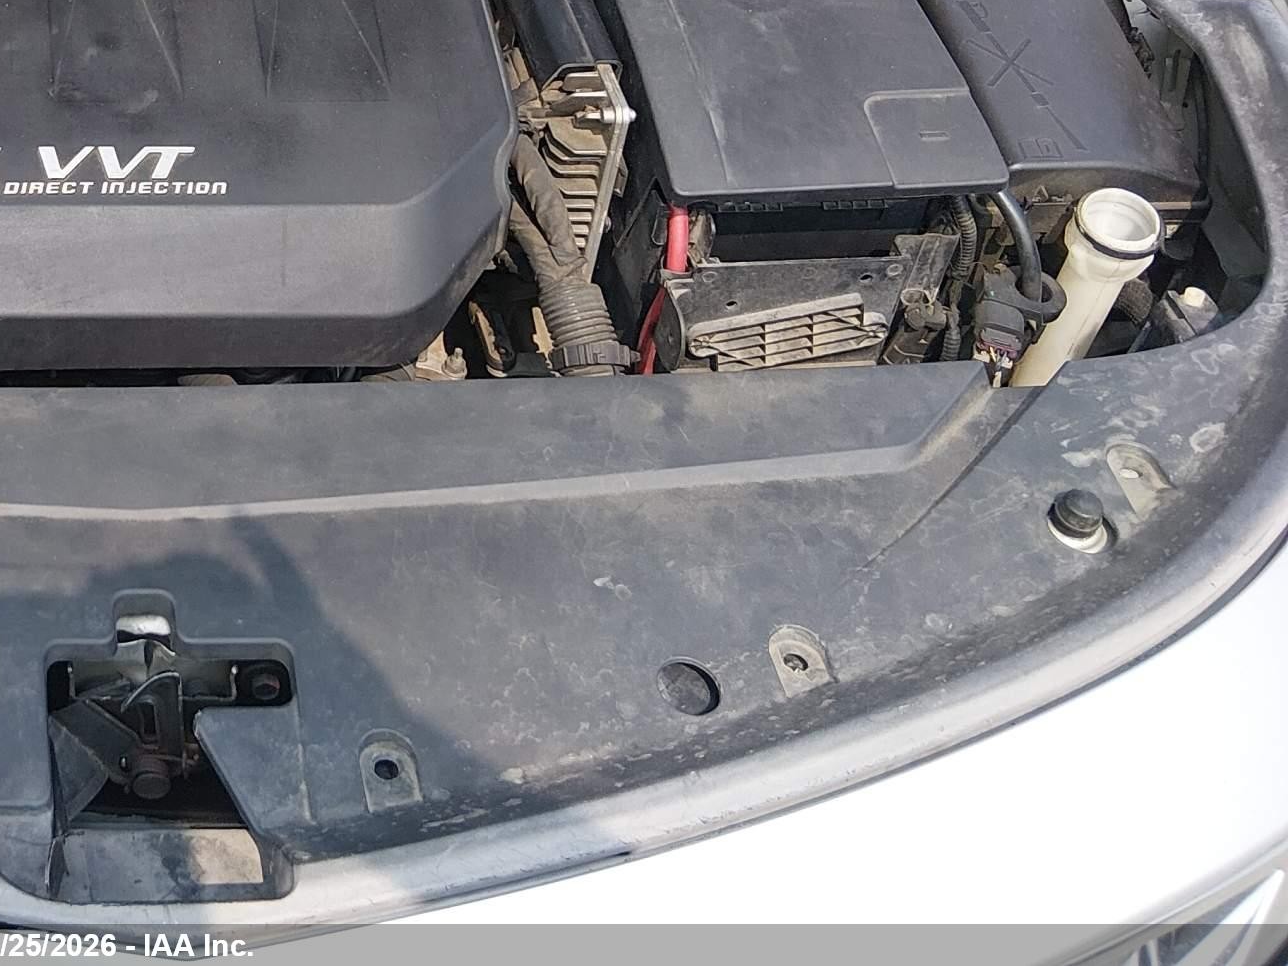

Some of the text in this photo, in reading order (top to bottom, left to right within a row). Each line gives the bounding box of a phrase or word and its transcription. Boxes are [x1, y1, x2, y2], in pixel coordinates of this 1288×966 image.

[37, 145, 196, 179] VVT
[3, 181, 228, 196] DIRECT INJECTION
